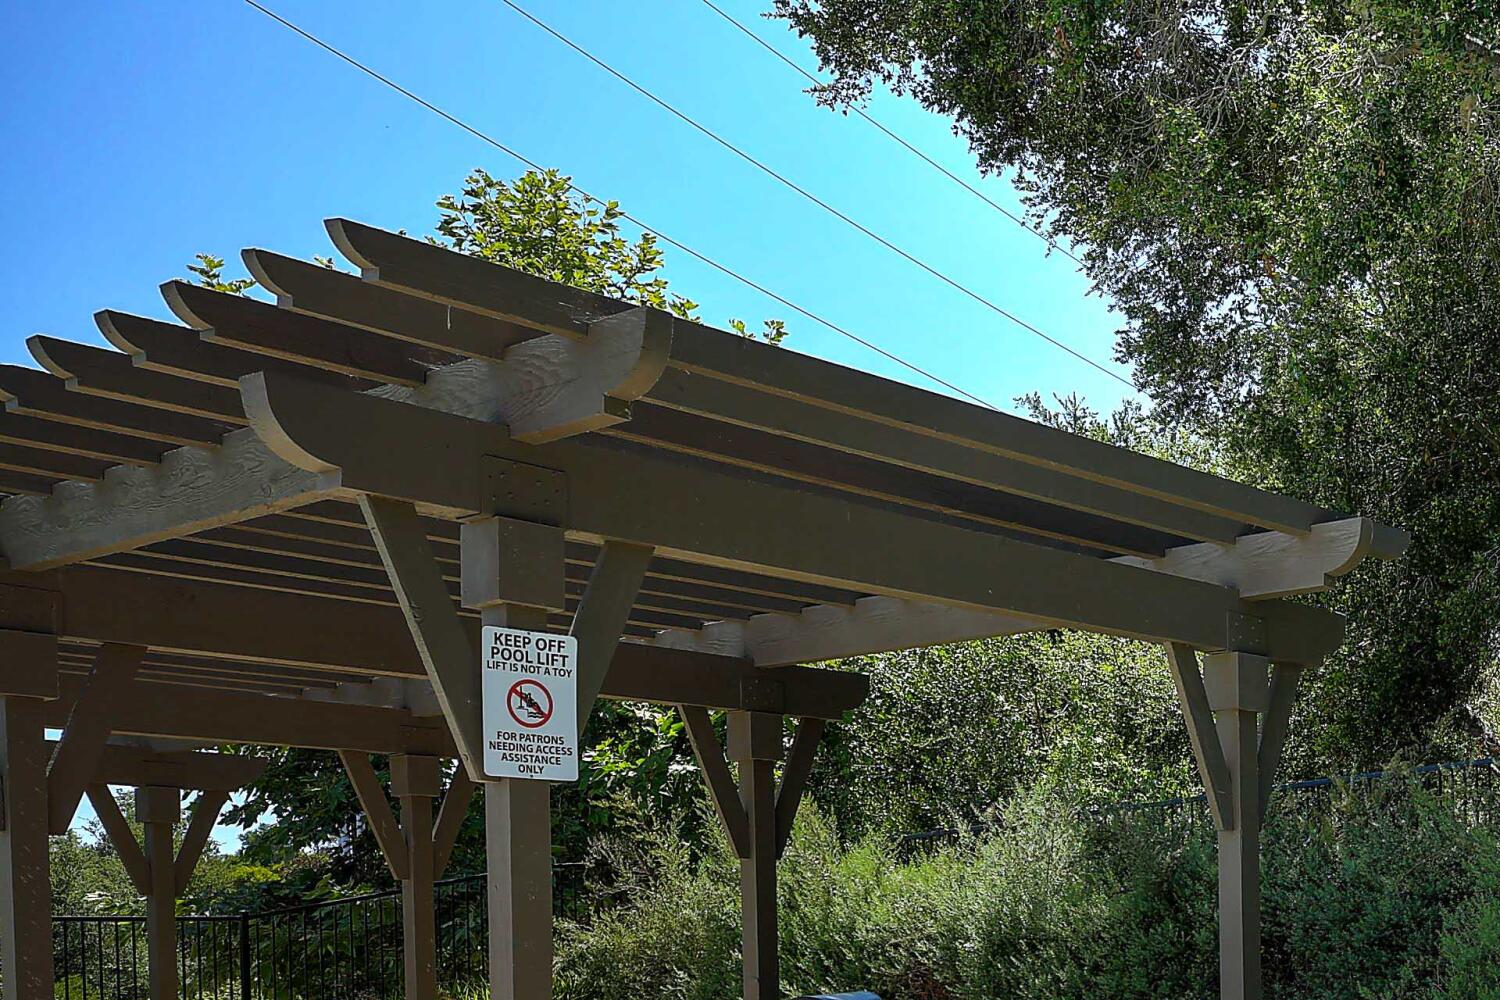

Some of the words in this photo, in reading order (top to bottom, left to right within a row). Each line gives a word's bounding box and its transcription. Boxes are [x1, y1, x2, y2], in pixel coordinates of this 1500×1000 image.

[494, 632, 531, 649] KEEP
[536, 638, 565, 653] OFF
[491, 646, 533, 663] POOL
[537, 652, 569, 667] LIFT
[487, 660, 507, 670] LIFT
[510, 663, 518, 672] IS
[521, 665, 542, 674] NOT
[552, 668, 572, 678] TOY
[497, 731, 516, 741] FOR
[520, 733, 564, 744] PATRONS
[489, 741, 533, 752] NEEDING
[536, 745, 572, 755] ACCESS
[501, 753, 561, 765] ASSISTANCE
[518, 765, 544, 774] ONLY
